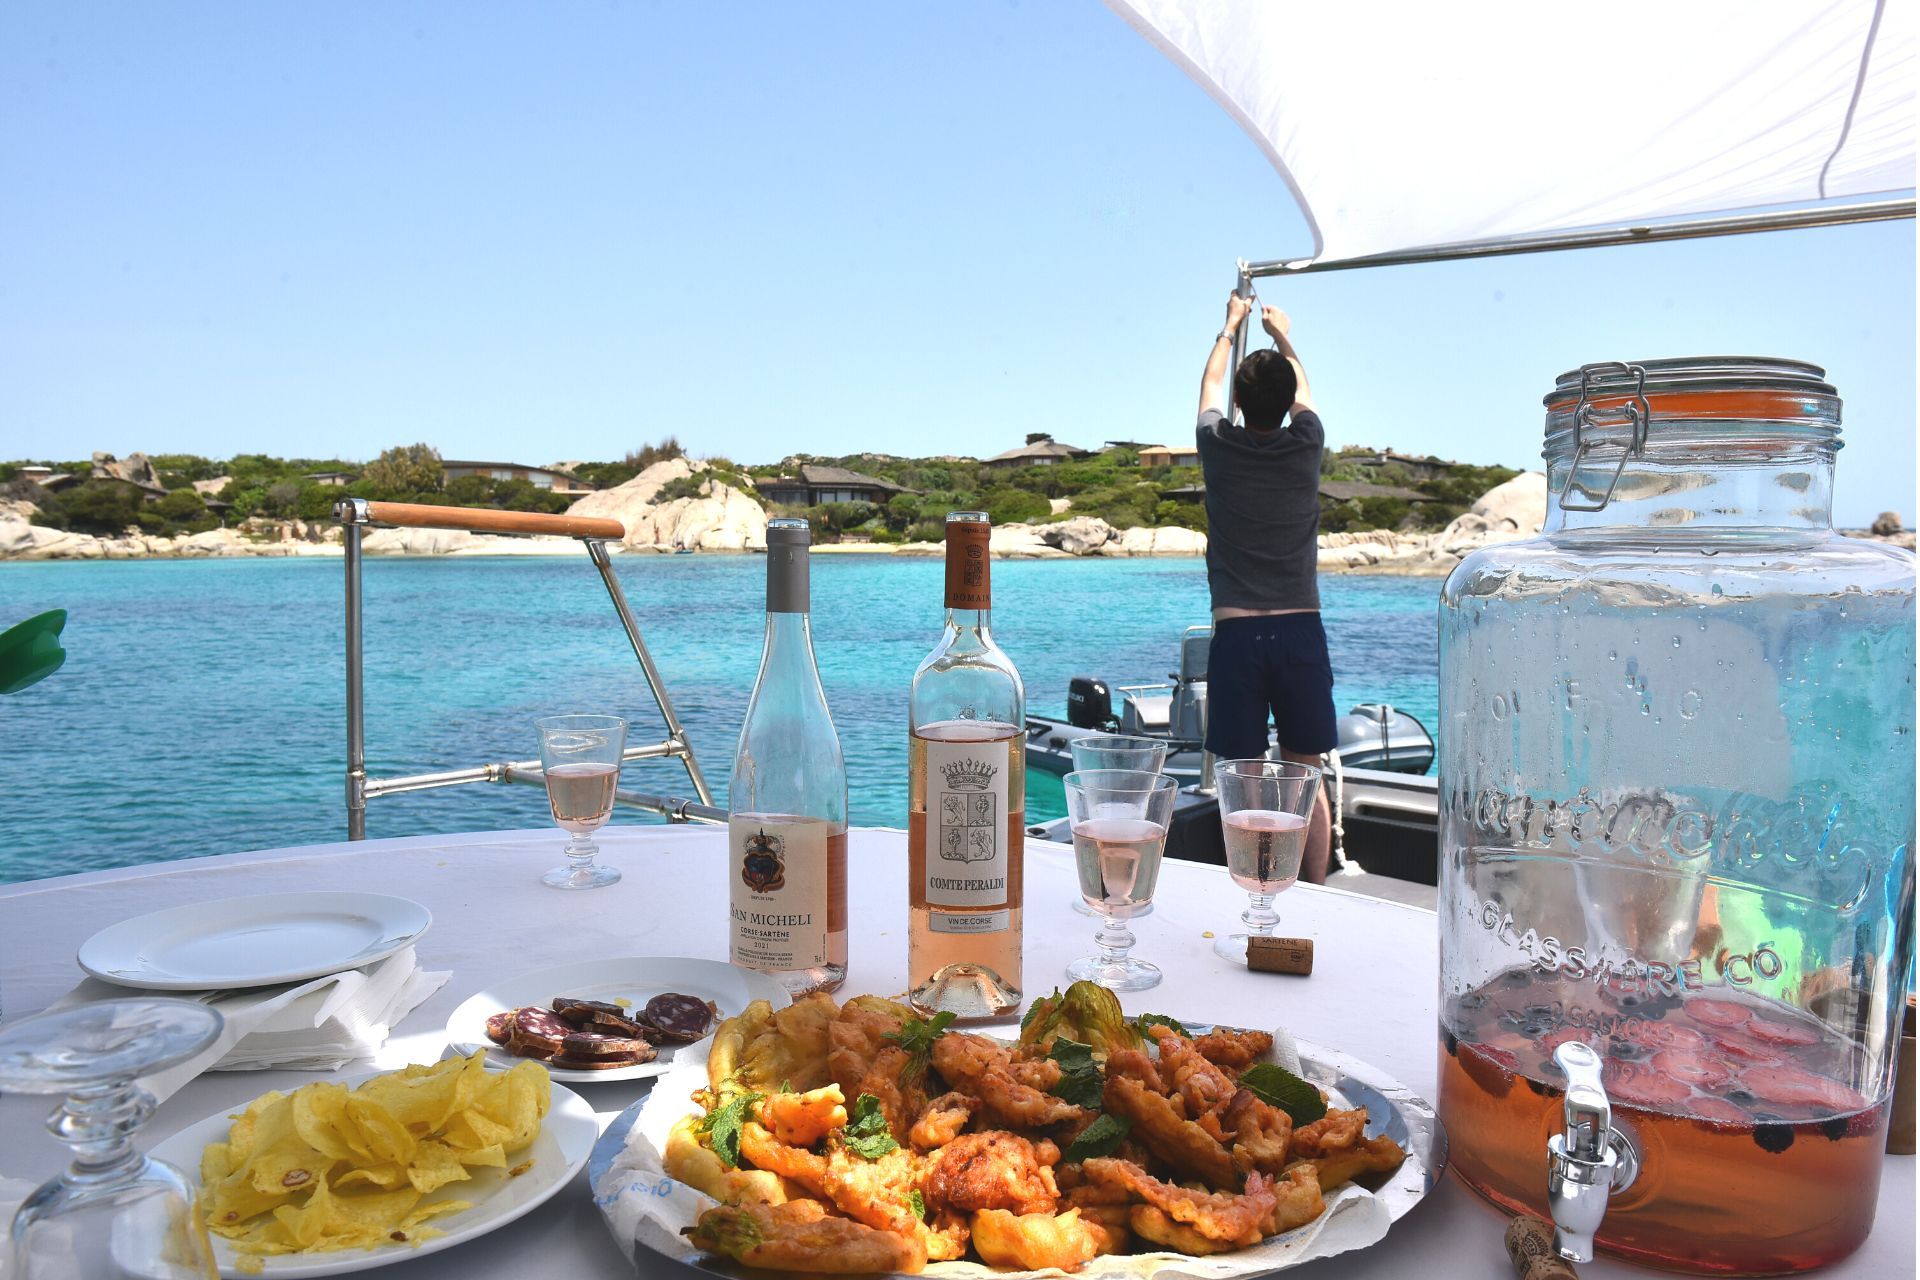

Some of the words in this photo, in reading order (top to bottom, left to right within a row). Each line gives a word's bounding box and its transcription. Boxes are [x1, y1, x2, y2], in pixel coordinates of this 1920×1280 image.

[930, 877, 963, 891] COMTE
[964, 877, 1004, 891] PERALDI
[730, 902, 747, 922] SAN
[750, 912, 812, 926] MICHELI
[947, 917, 959, 925] VIN
[970, 916, 993, 925] CORSE
[754, 941, 770, 949] 2021
